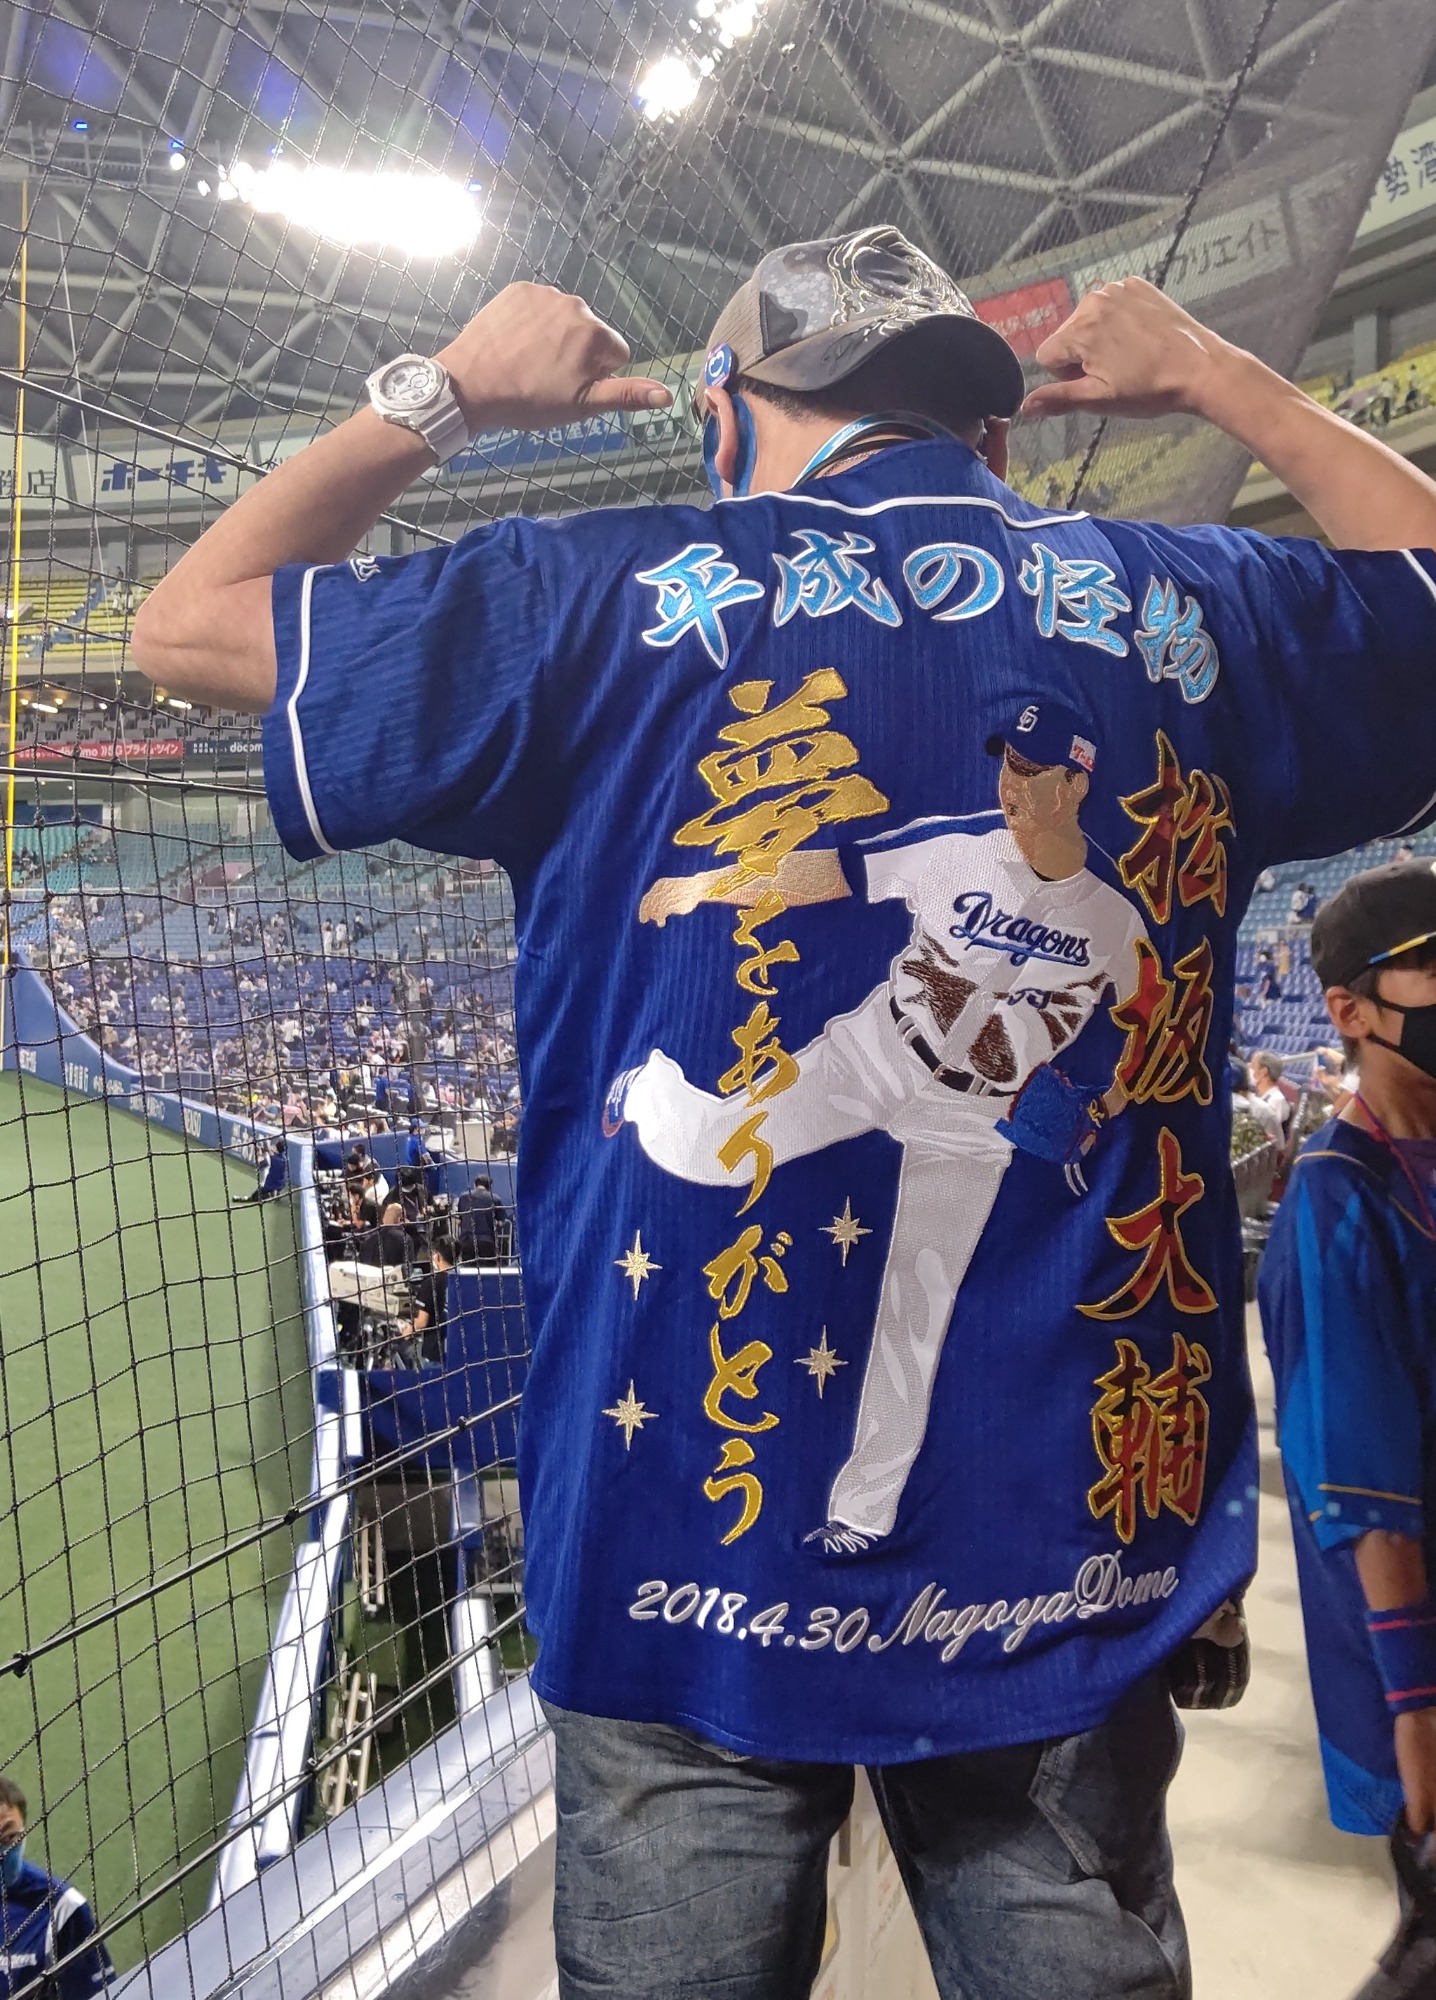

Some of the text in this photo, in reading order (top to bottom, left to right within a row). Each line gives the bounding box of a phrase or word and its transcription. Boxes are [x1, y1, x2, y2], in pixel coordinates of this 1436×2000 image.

[101, 455, 227, 492] ホーチキ
[635, 528, 1220, 704] 平成の怪物
[57, 746, 99, 758] doomo
[949, 891, 1091, 967] Dragons
[673, 667, 891, 1546] 夢をありがとう
[1075, 728, 1237, 1545] 松坂大輔
